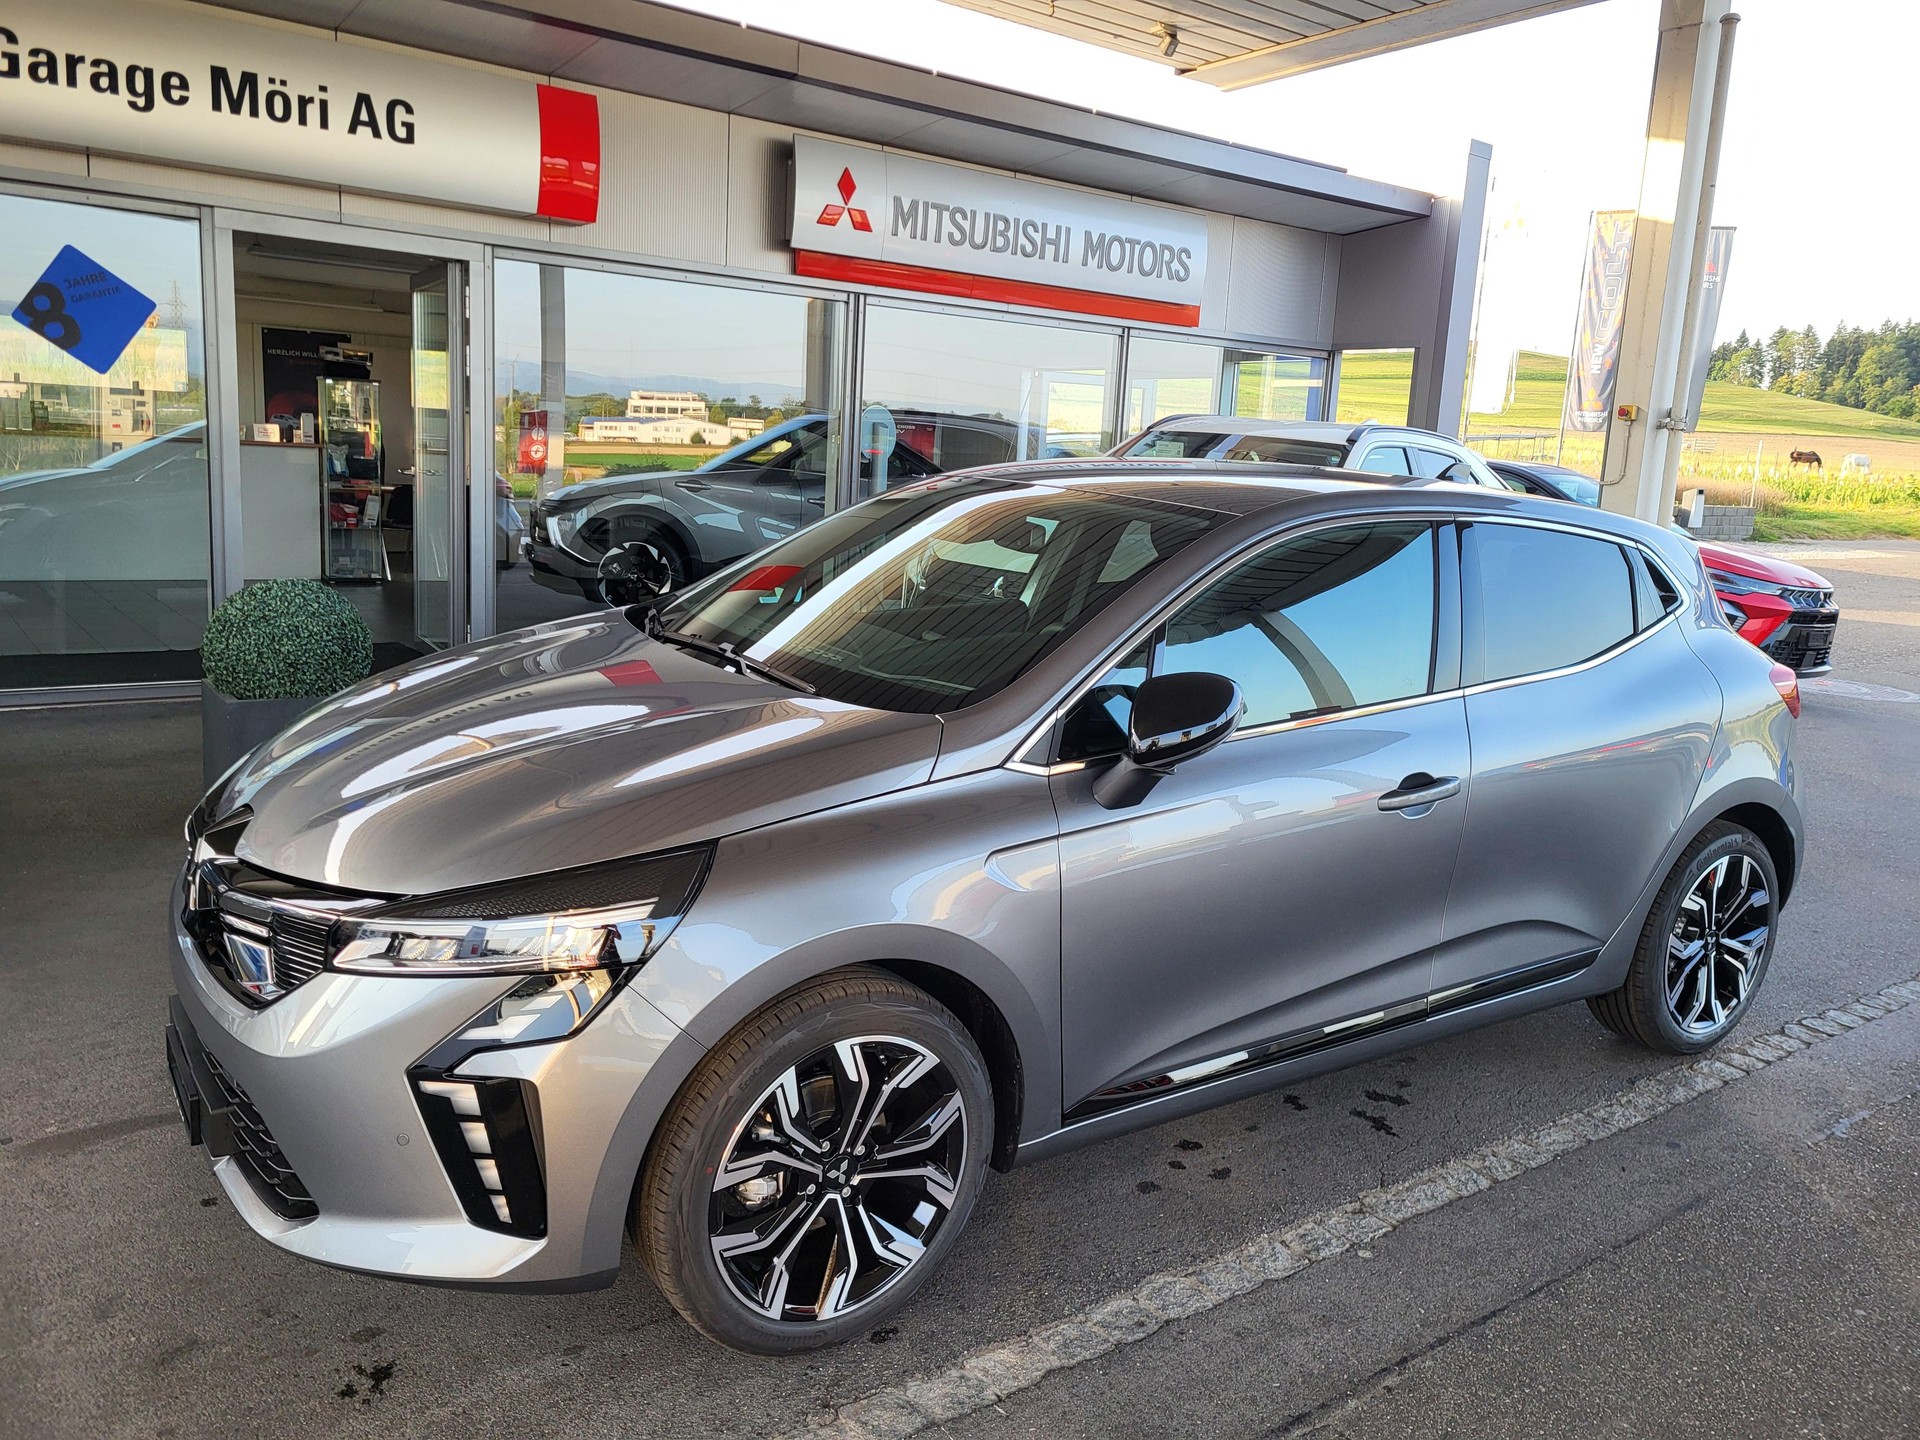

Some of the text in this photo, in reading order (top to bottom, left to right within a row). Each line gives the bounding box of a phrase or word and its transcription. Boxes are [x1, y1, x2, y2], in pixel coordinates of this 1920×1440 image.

[0, 26, 415, 144] Garage Möri AG
[891, 195, 1192, 282] MITSUBISHI MOTORS
[63, 271, 108, 290] JAHRE
[70, 286, 121, 303] GARANTIE
[1590, 221, 1632, 375] NEW COLT
[18, 282, 81, 350] 8
[267, 348, 300, 357] HERZLICH
